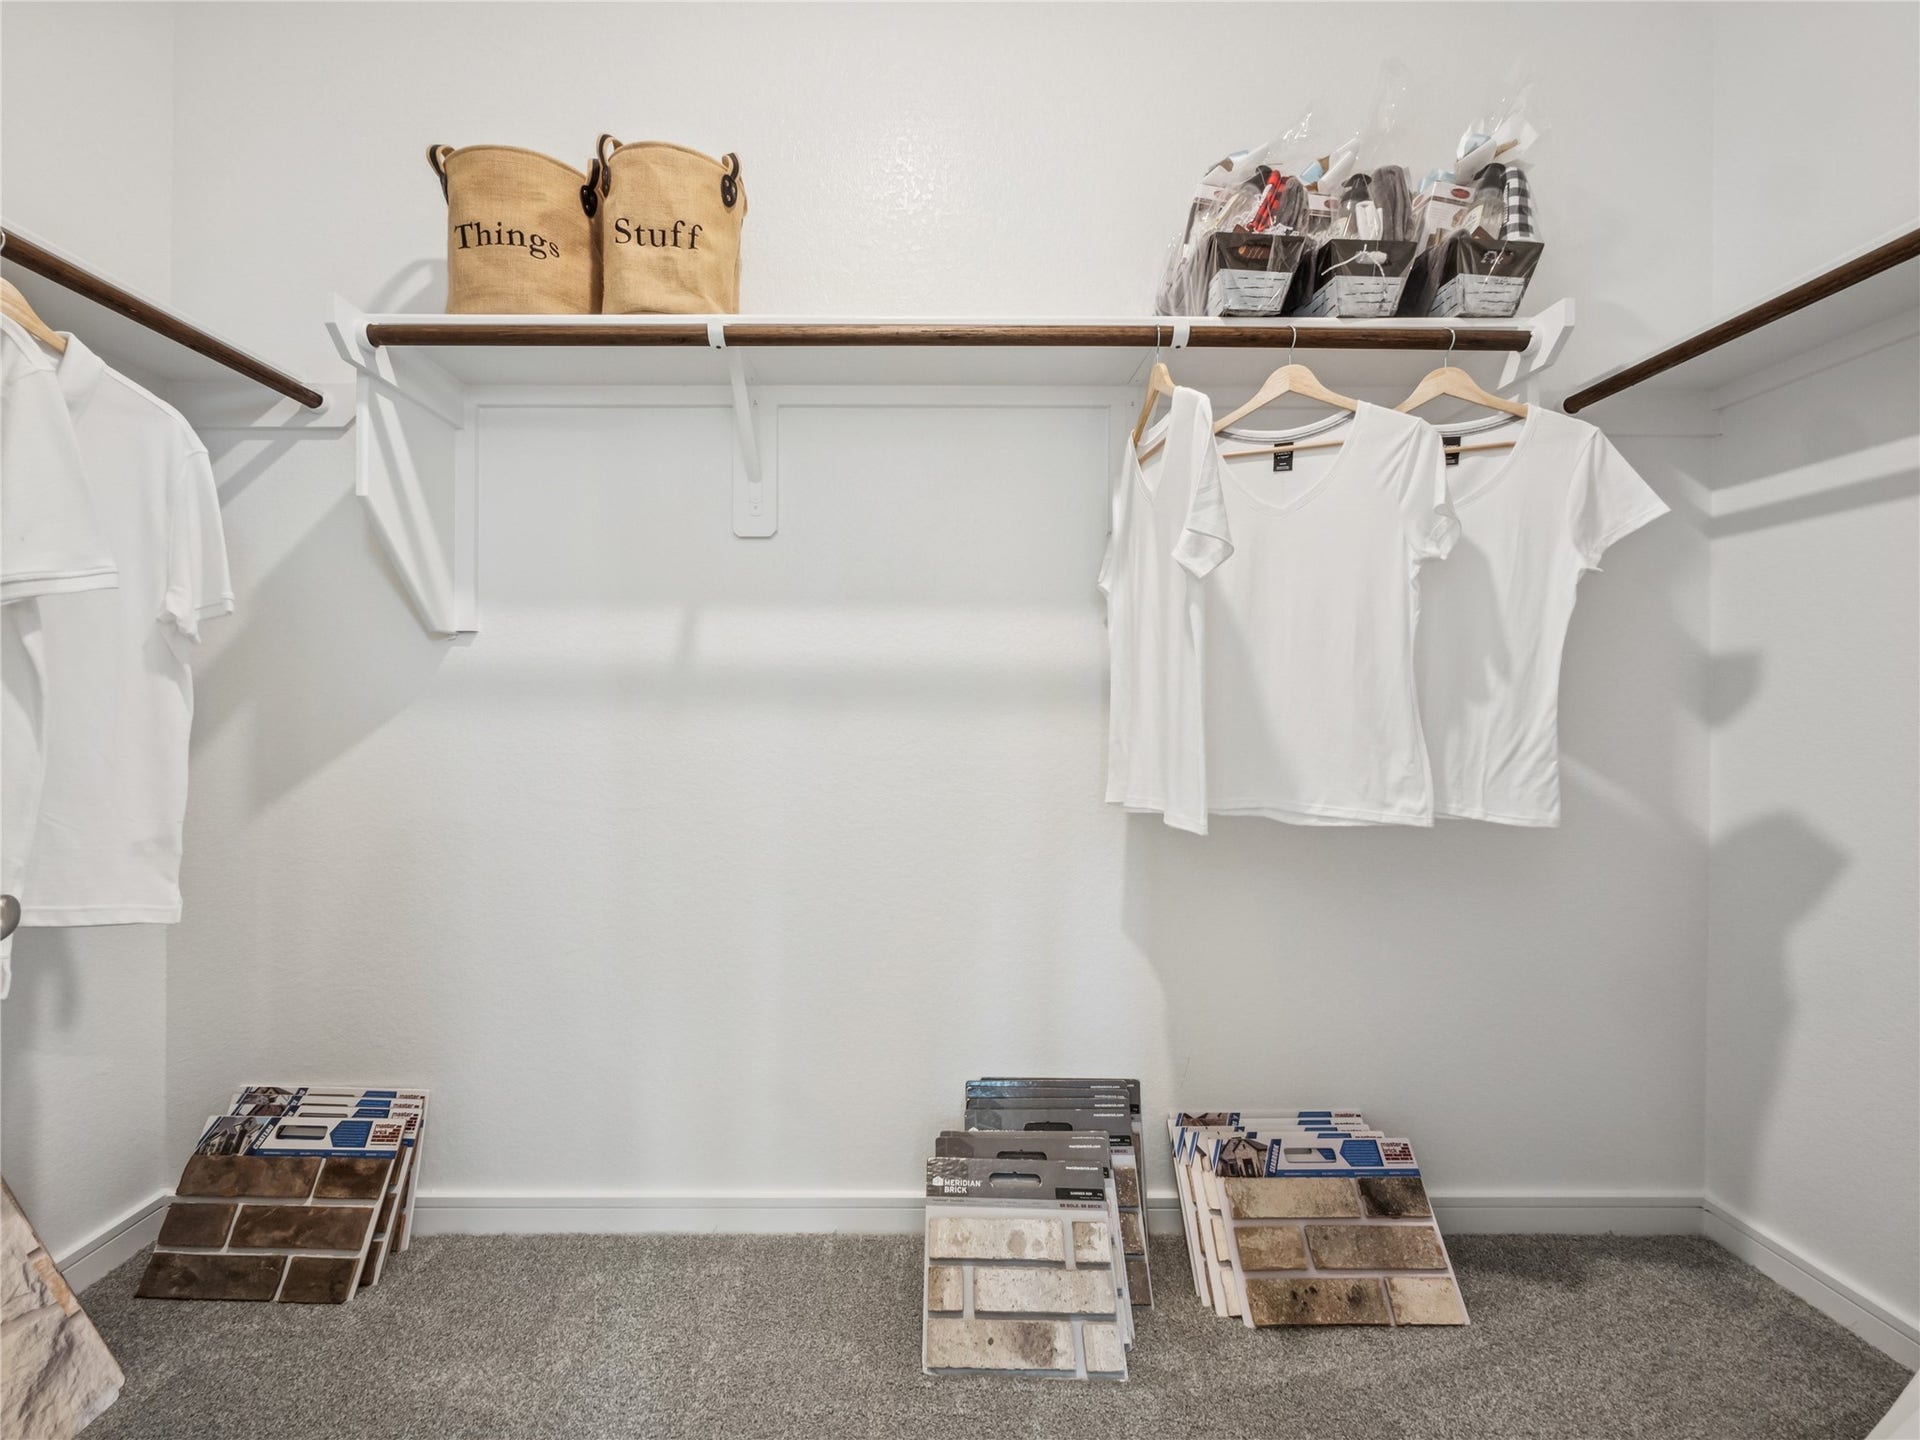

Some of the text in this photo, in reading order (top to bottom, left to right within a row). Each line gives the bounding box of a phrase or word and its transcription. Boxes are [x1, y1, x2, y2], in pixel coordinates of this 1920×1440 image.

[454, 221, 560, 260] Things
[614, 217, 703, 250] Stuff
[944, 1178, 981, 1187] MERIDIAN
[944, 1186, 968, 1194] BRICK
